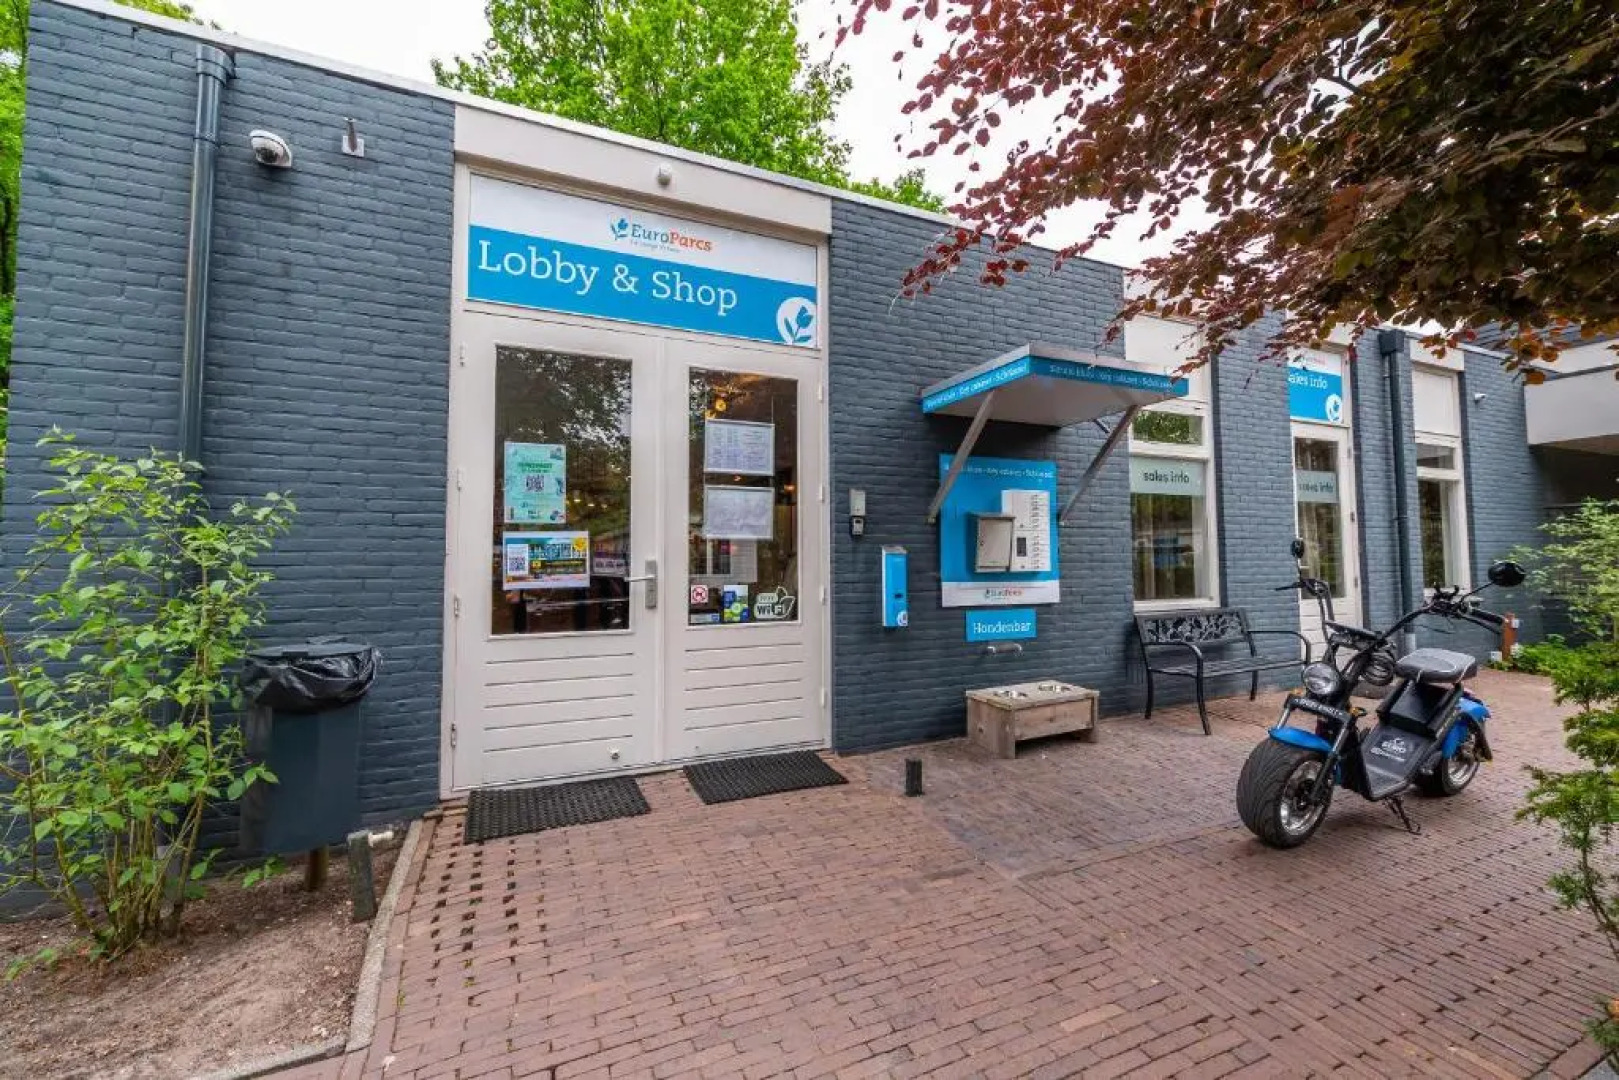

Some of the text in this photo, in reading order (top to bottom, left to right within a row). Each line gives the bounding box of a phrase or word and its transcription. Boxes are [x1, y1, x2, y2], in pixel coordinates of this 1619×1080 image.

[630, 223, 713, 252] EuroParcs
[478, 239, 738, 317] Lobby & Shop
[1288, 372, 1328, 390] ales info
[1143, 469, 1190, 484] sales info
[973, 621, 1032, 634] Hondenbar
